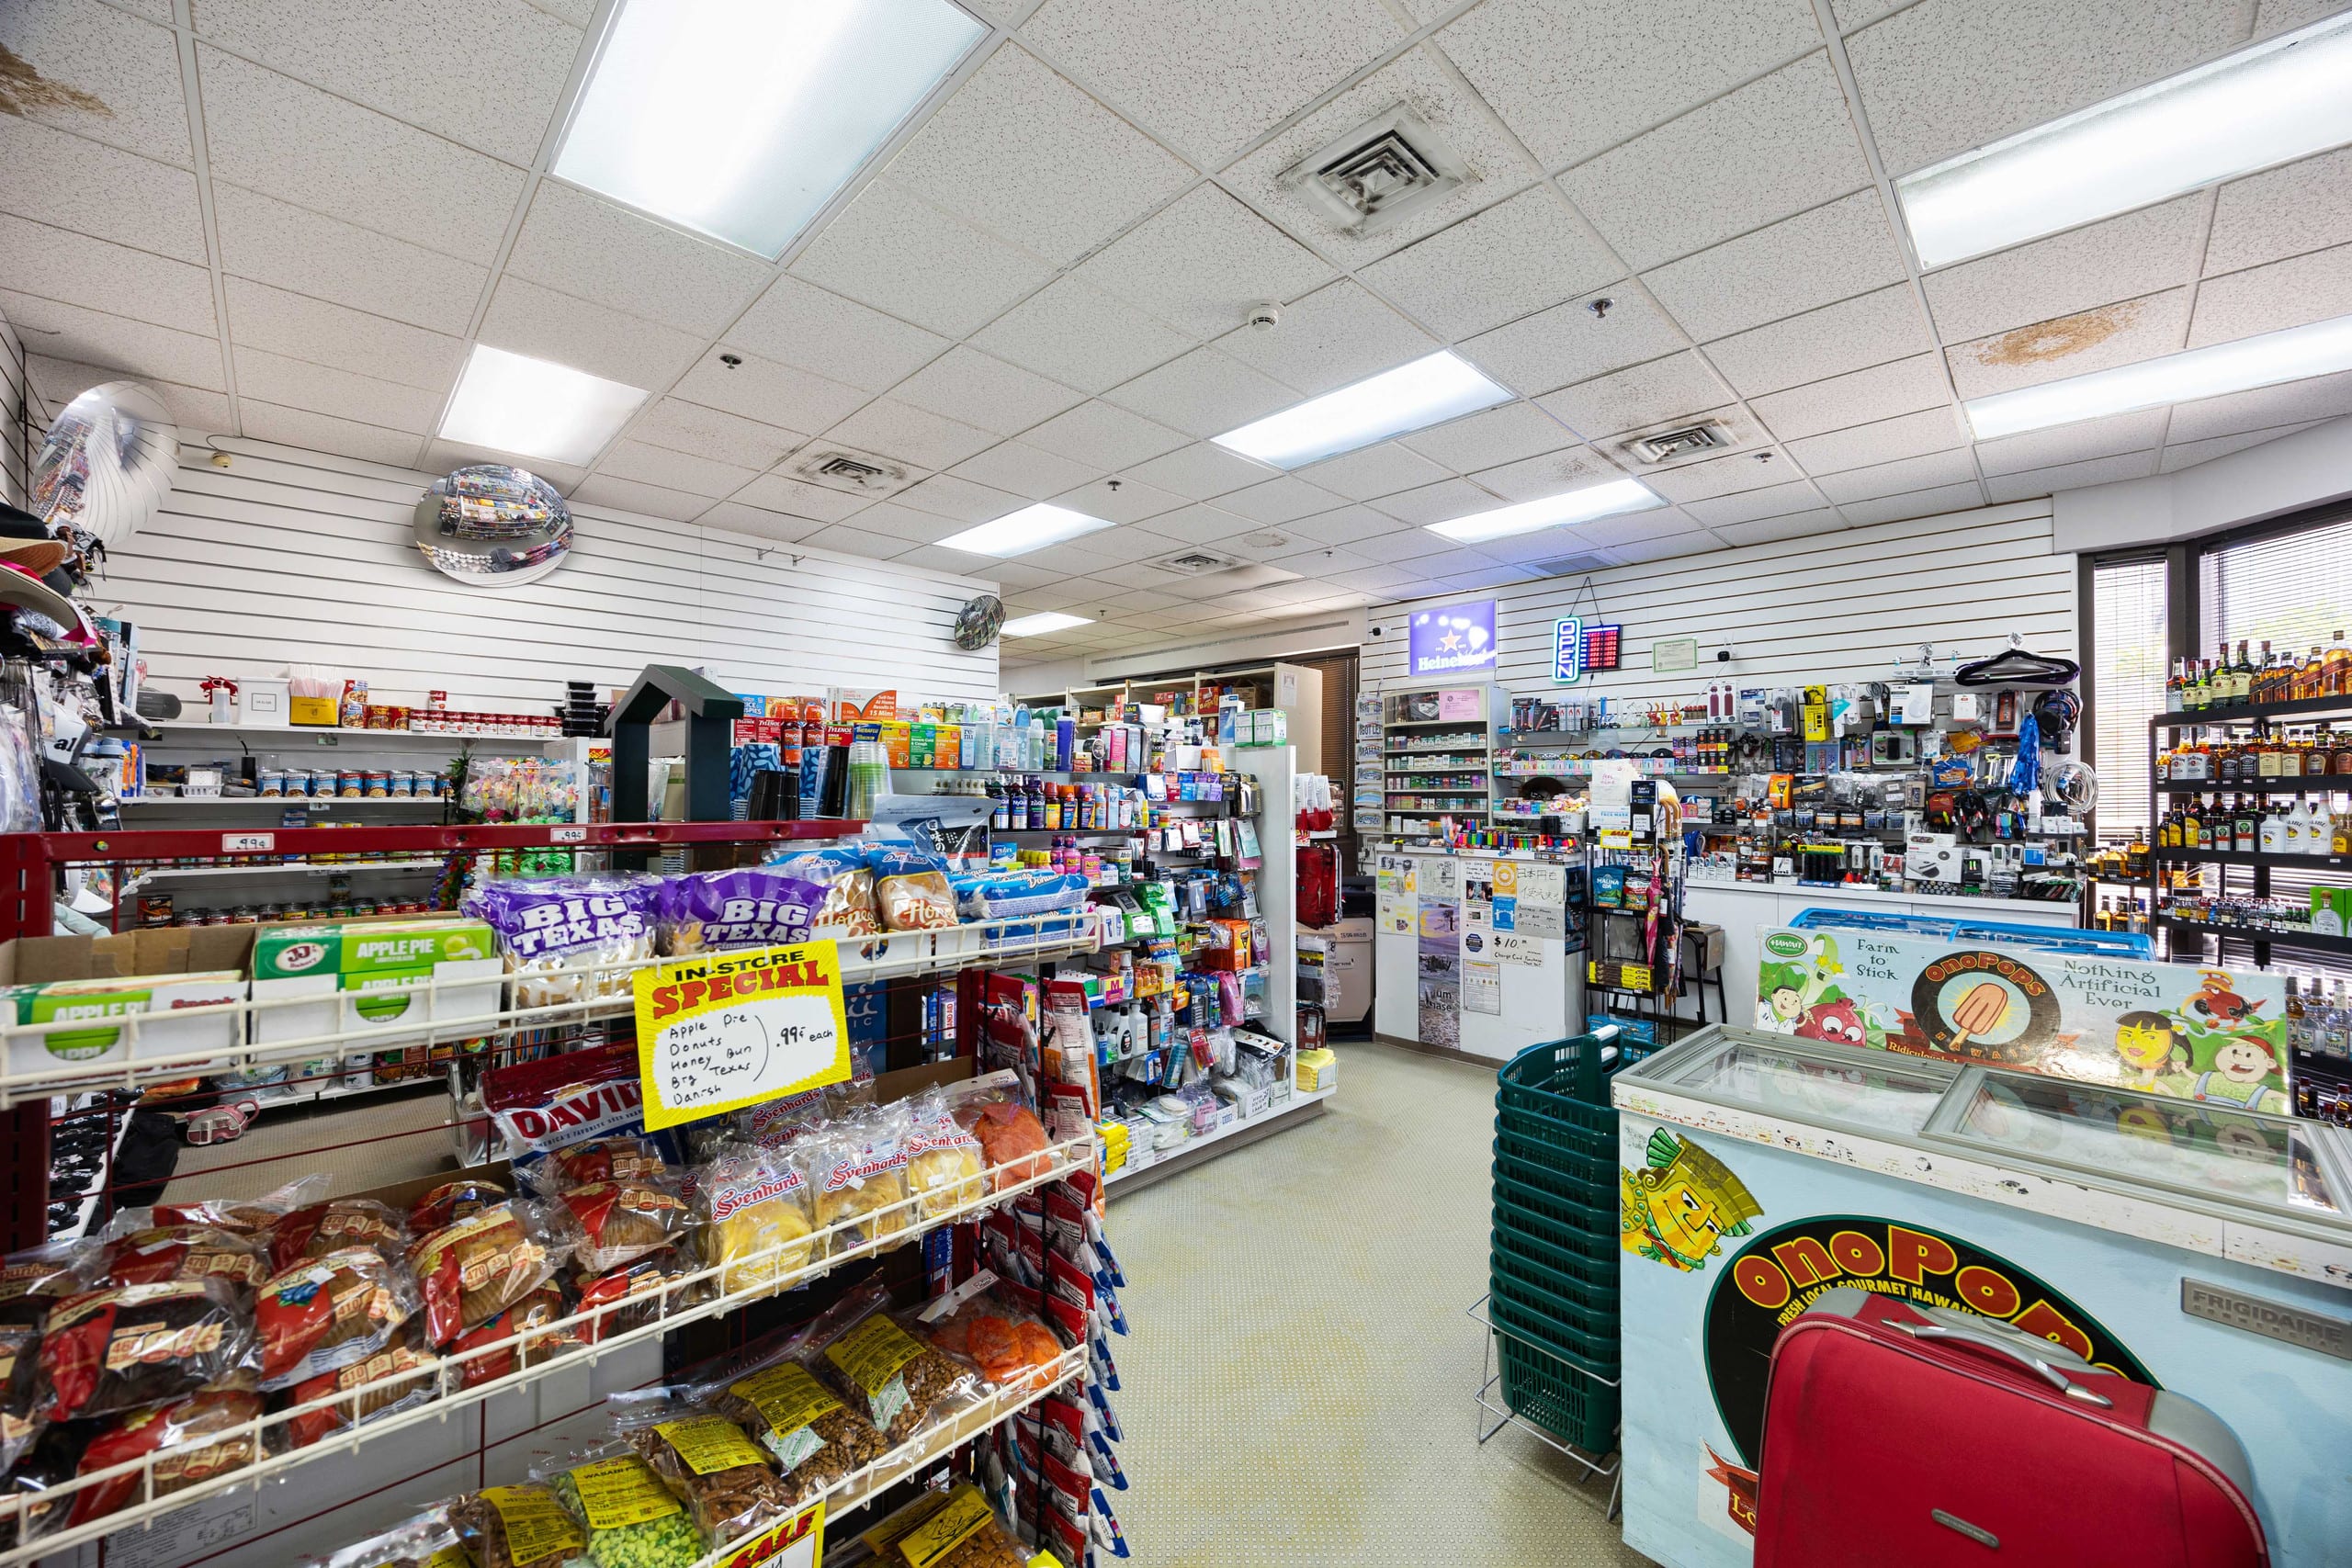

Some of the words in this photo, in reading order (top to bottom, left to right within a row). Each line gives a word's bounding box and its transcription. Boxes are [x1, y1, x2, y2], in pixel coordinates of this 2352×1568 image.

[1557, 621, 1576, 678] OPEN
[520, 895, 629, 930] BIG
[722, 898, 810, 928] BIG
[513, 915, 645, 956] TEXAS
[704, 920, 810, 946] TEXAS
[356, 941, 409, 959] APPLE
[409, 939, 435, 954] PIE
[1857, 939, 1900, 954] Farm
[675, 950, 805, 982] IN-STORE
[1857, 964, 1899, 980] Stick
[1870, 955, 1886, 965] to
[2064, 960, 2155, 985] Nothing
[1926, 953, 2046, 997] OnoPops
[2059, 974, 2161, 998] Artificial
[651, 960, 830, 1020] SPECIAL
[2086, 991, 2133, 1010] Ever
[53, 1002, 123, 1022] APPLE
[669, 1022, 707, 1040] Apple
[723, 1013, 748, 1028] Pie
[808, 1029, 833, 1043] each
[670, 1037, 722, 1055] Donuts
[670, 1055, 712, 1072] Honey
[726, 1044, 752, 1059] Bun
[1888, 1041, 1950, 1061] Ridicul
[671, 1075, 697, 1089] Big
[709, 1062, 751, 1077] Texas
[673, 1085, 721, 1106] Danish
[572, 1122, 605, 1137] FAVORITE
[607, 1114, 624, 1125] SEED
[826, 1150, 909, 1190] Svenhard's
[712, 1170, 804, 1222] Svenhard's
[466, 1264, 487, 1281] 470
[1734, 1224, 2130, 1381] OnoPop
[1776, 1300, 1807, 1326] FRESH
[1804, 1282, 1834, 1305] LOCAL
[1838, 1279, 1907, 1297] GOURMET
[2192, 1289, 2344, 1342] FRIGIDAIRE
[342, 1367, 367, 1384] 410
